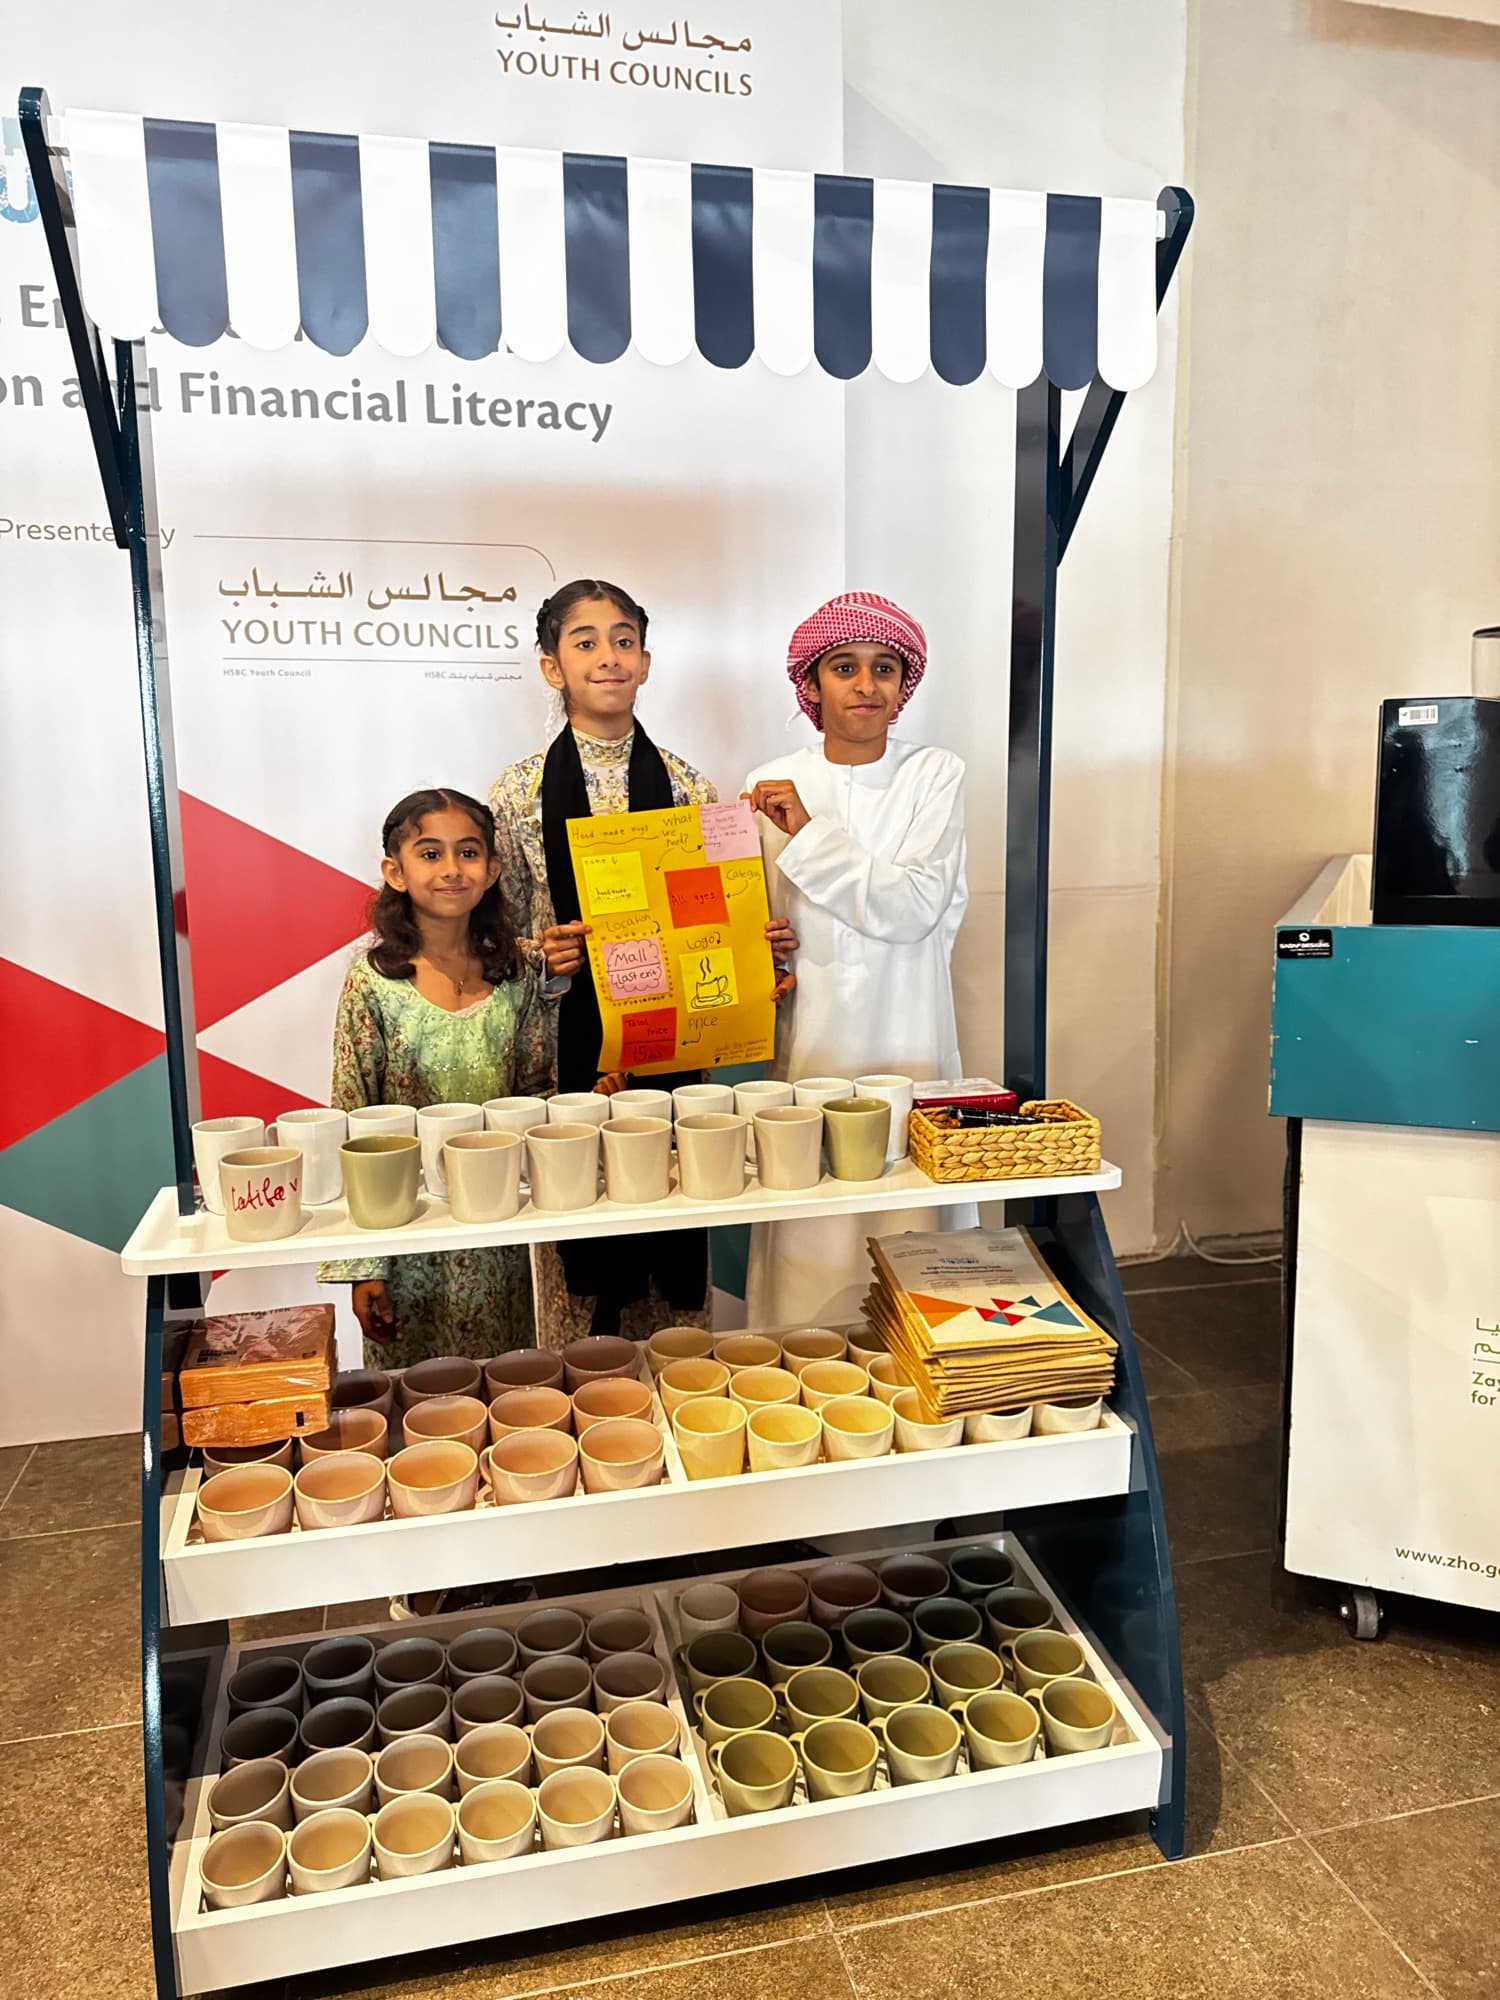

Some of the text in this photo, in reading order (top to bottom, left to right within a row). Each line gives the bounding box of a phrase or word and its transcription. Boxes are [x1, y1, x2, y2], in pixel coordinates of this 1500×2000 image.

[494, 2, 752, 59] مجالس الشباب
[496, 48, 753, 97] YOUTH COUNCILS
[0, 373, 44, 407] n
[179, 370, 407, 424] Financial
[424, 382, 613, 444] Literacy
[0, 517, 116, 542] Presente
[218, 566, 518, 613] مجالس الشباب
[220, 618, 520, 650] YOUTH COUNCILS
[223, 668, 312, 678] HSBC Youth Council
[614, 947, 648, 966] Mall
[1472, 1390, 1497, 1406] for
[1395, 1546, 1500, 1578] www.zho.g
